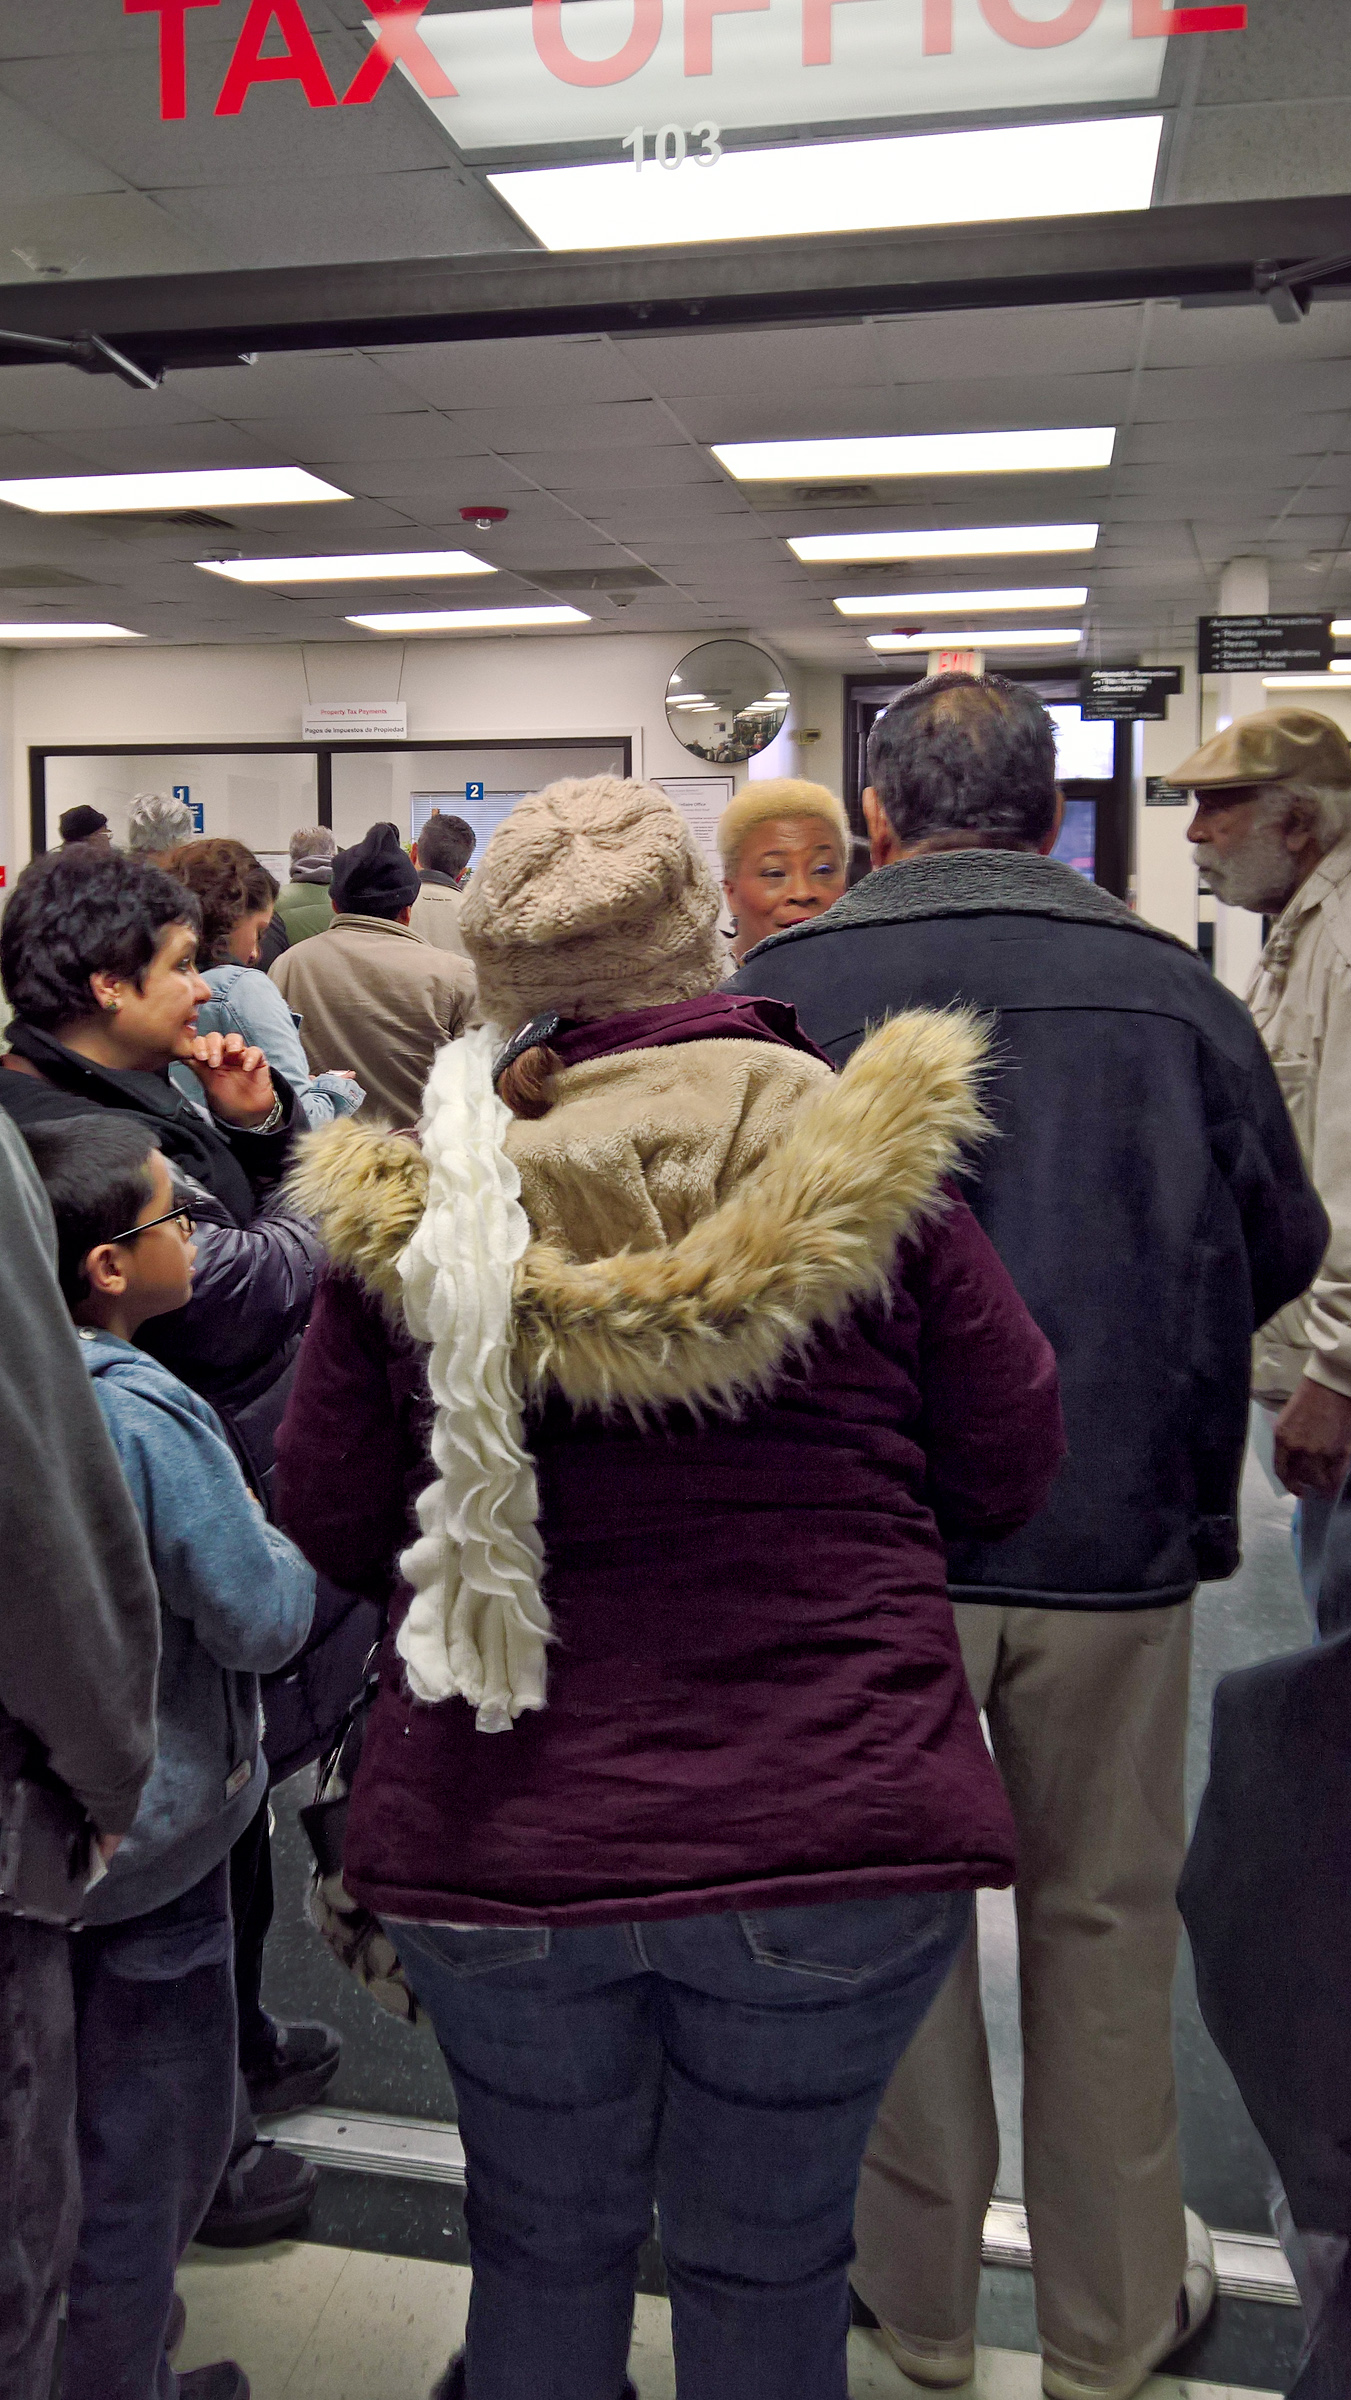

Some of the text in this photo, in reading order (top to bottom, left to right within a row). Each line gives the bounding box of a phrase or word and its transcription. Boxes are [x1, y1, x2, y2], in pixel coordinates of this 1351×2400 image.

[122, 0, 461, 120] TAX
[622, 120, 722, 172] 103
[373, 726, 404, 734] Propiedad
[177, 788, 185, 801] 1
[470, 784, 479, 798] 2
